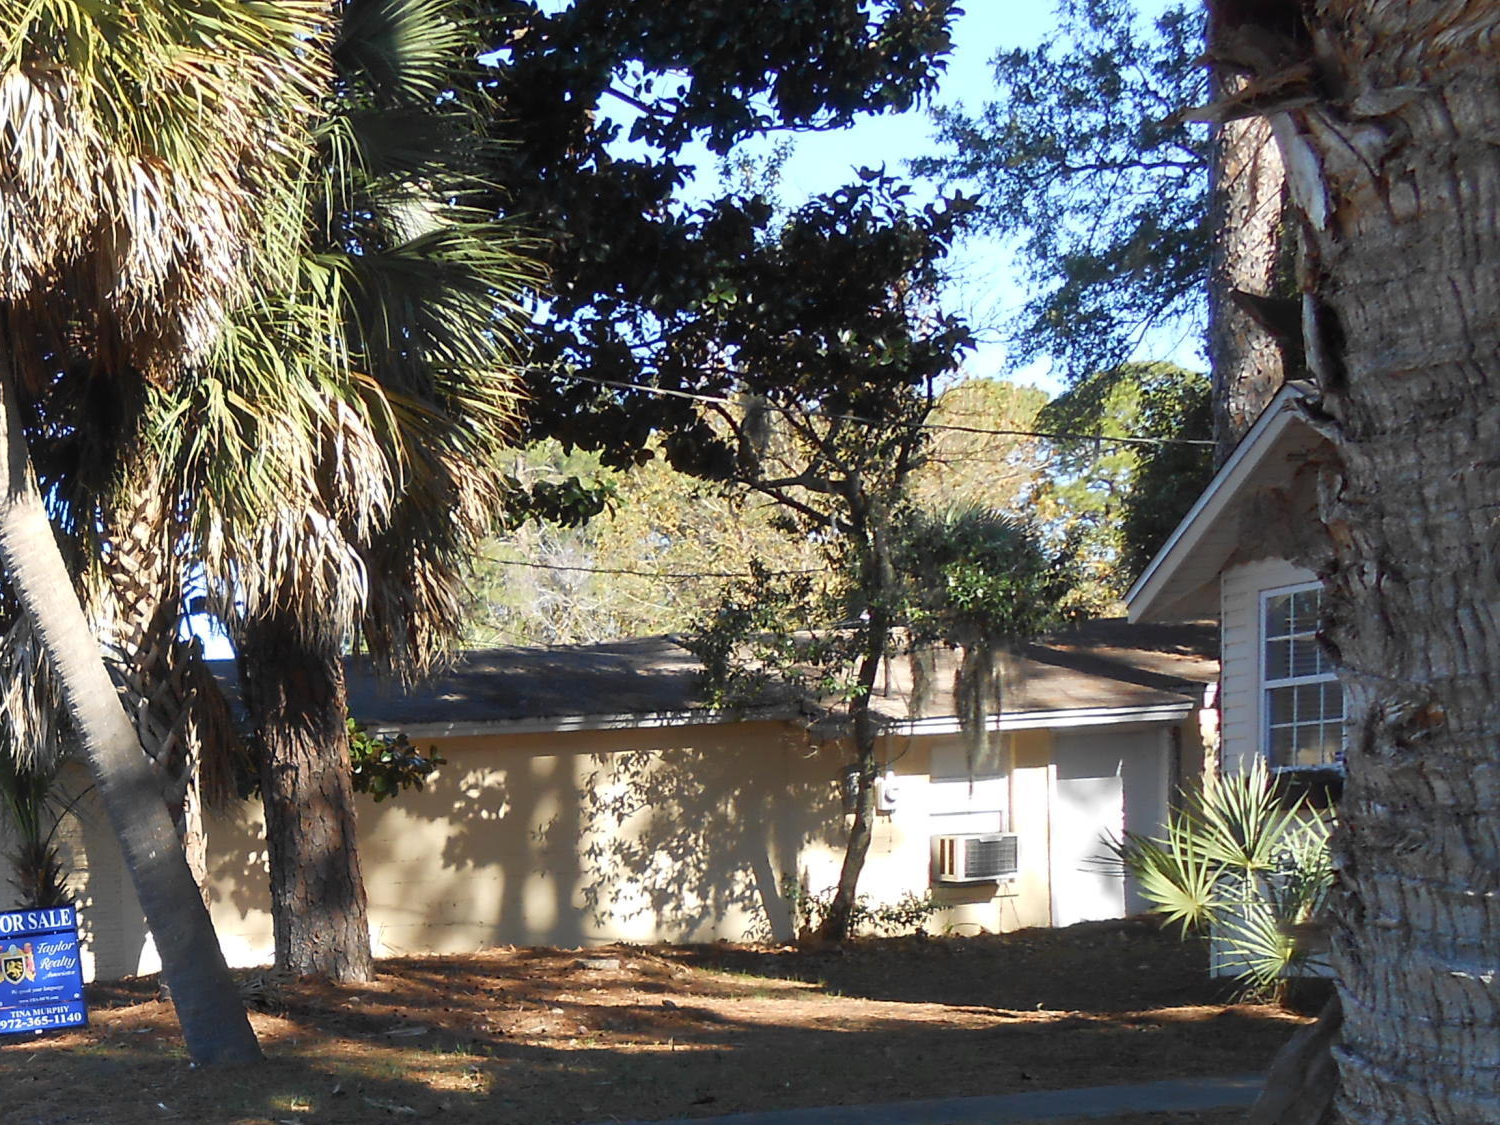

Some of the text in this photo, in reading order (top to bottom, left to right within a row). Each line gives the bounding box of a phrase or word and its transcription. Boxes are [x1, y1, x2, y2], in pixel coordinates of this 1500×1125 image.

[28, 908, 72, 930] SALE
[37, 940, 75, 956] Taylor
[40, 956, 76, 970] Realty
[10, 1005, 70, 1018] TINA MURPHY
[0, 1012, 82, 1030] 972-365-1140
